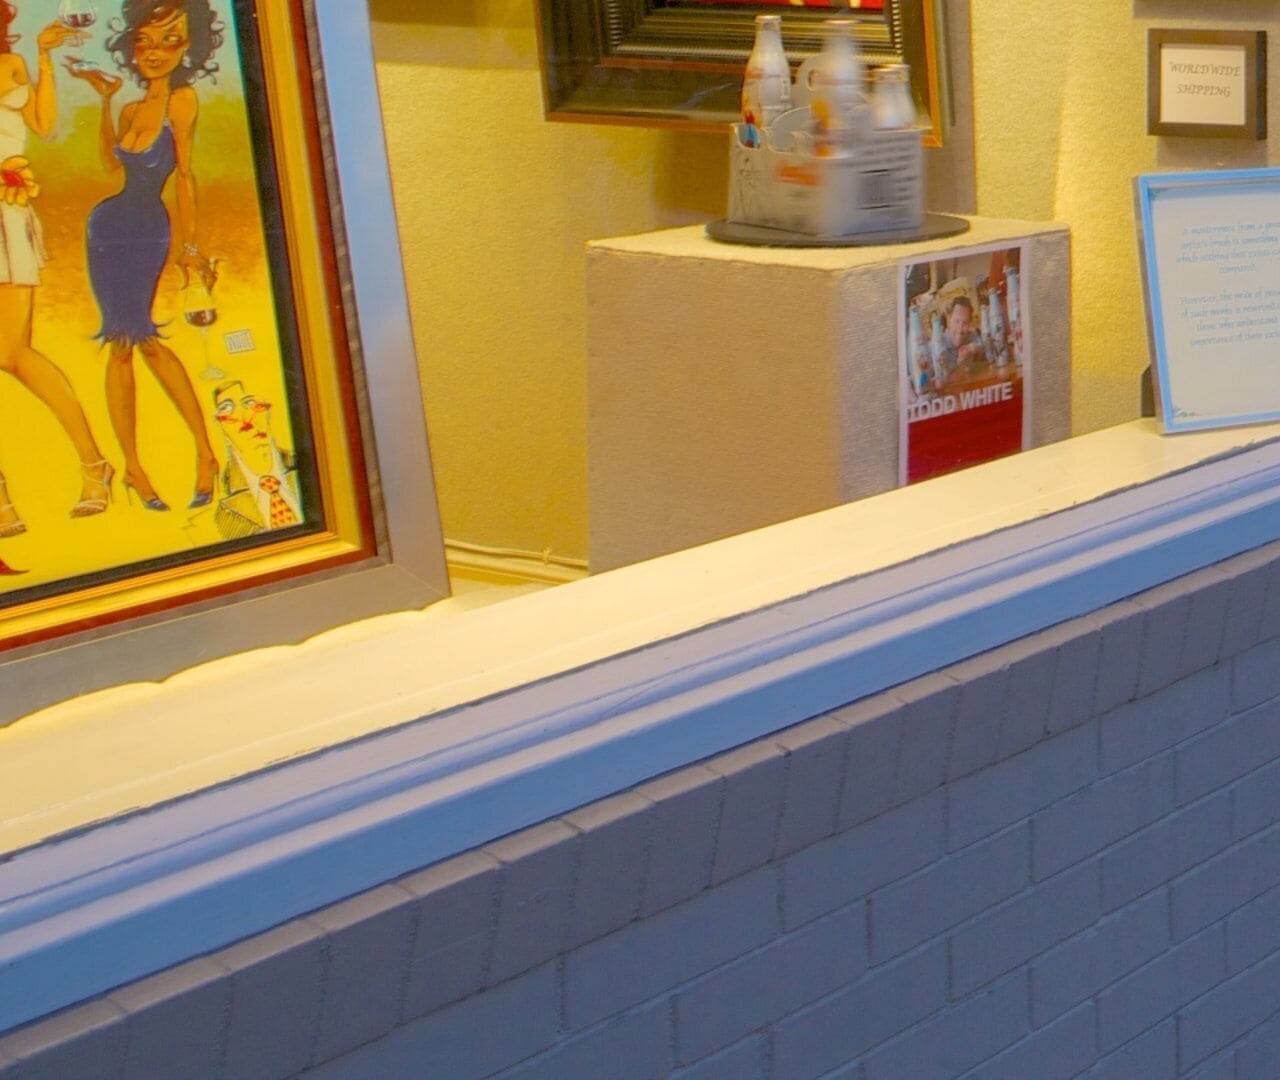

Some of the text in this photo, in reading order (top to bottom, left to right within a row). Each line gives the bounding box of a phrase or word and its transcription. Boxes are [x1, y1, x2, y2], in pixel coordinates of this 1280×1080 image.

[1168, 60, 1241, 77] WORLDWIDE
[1176, 82, 1232, 98] SHIPPING
[907, 382, 1013, 419] TODD WHITE
